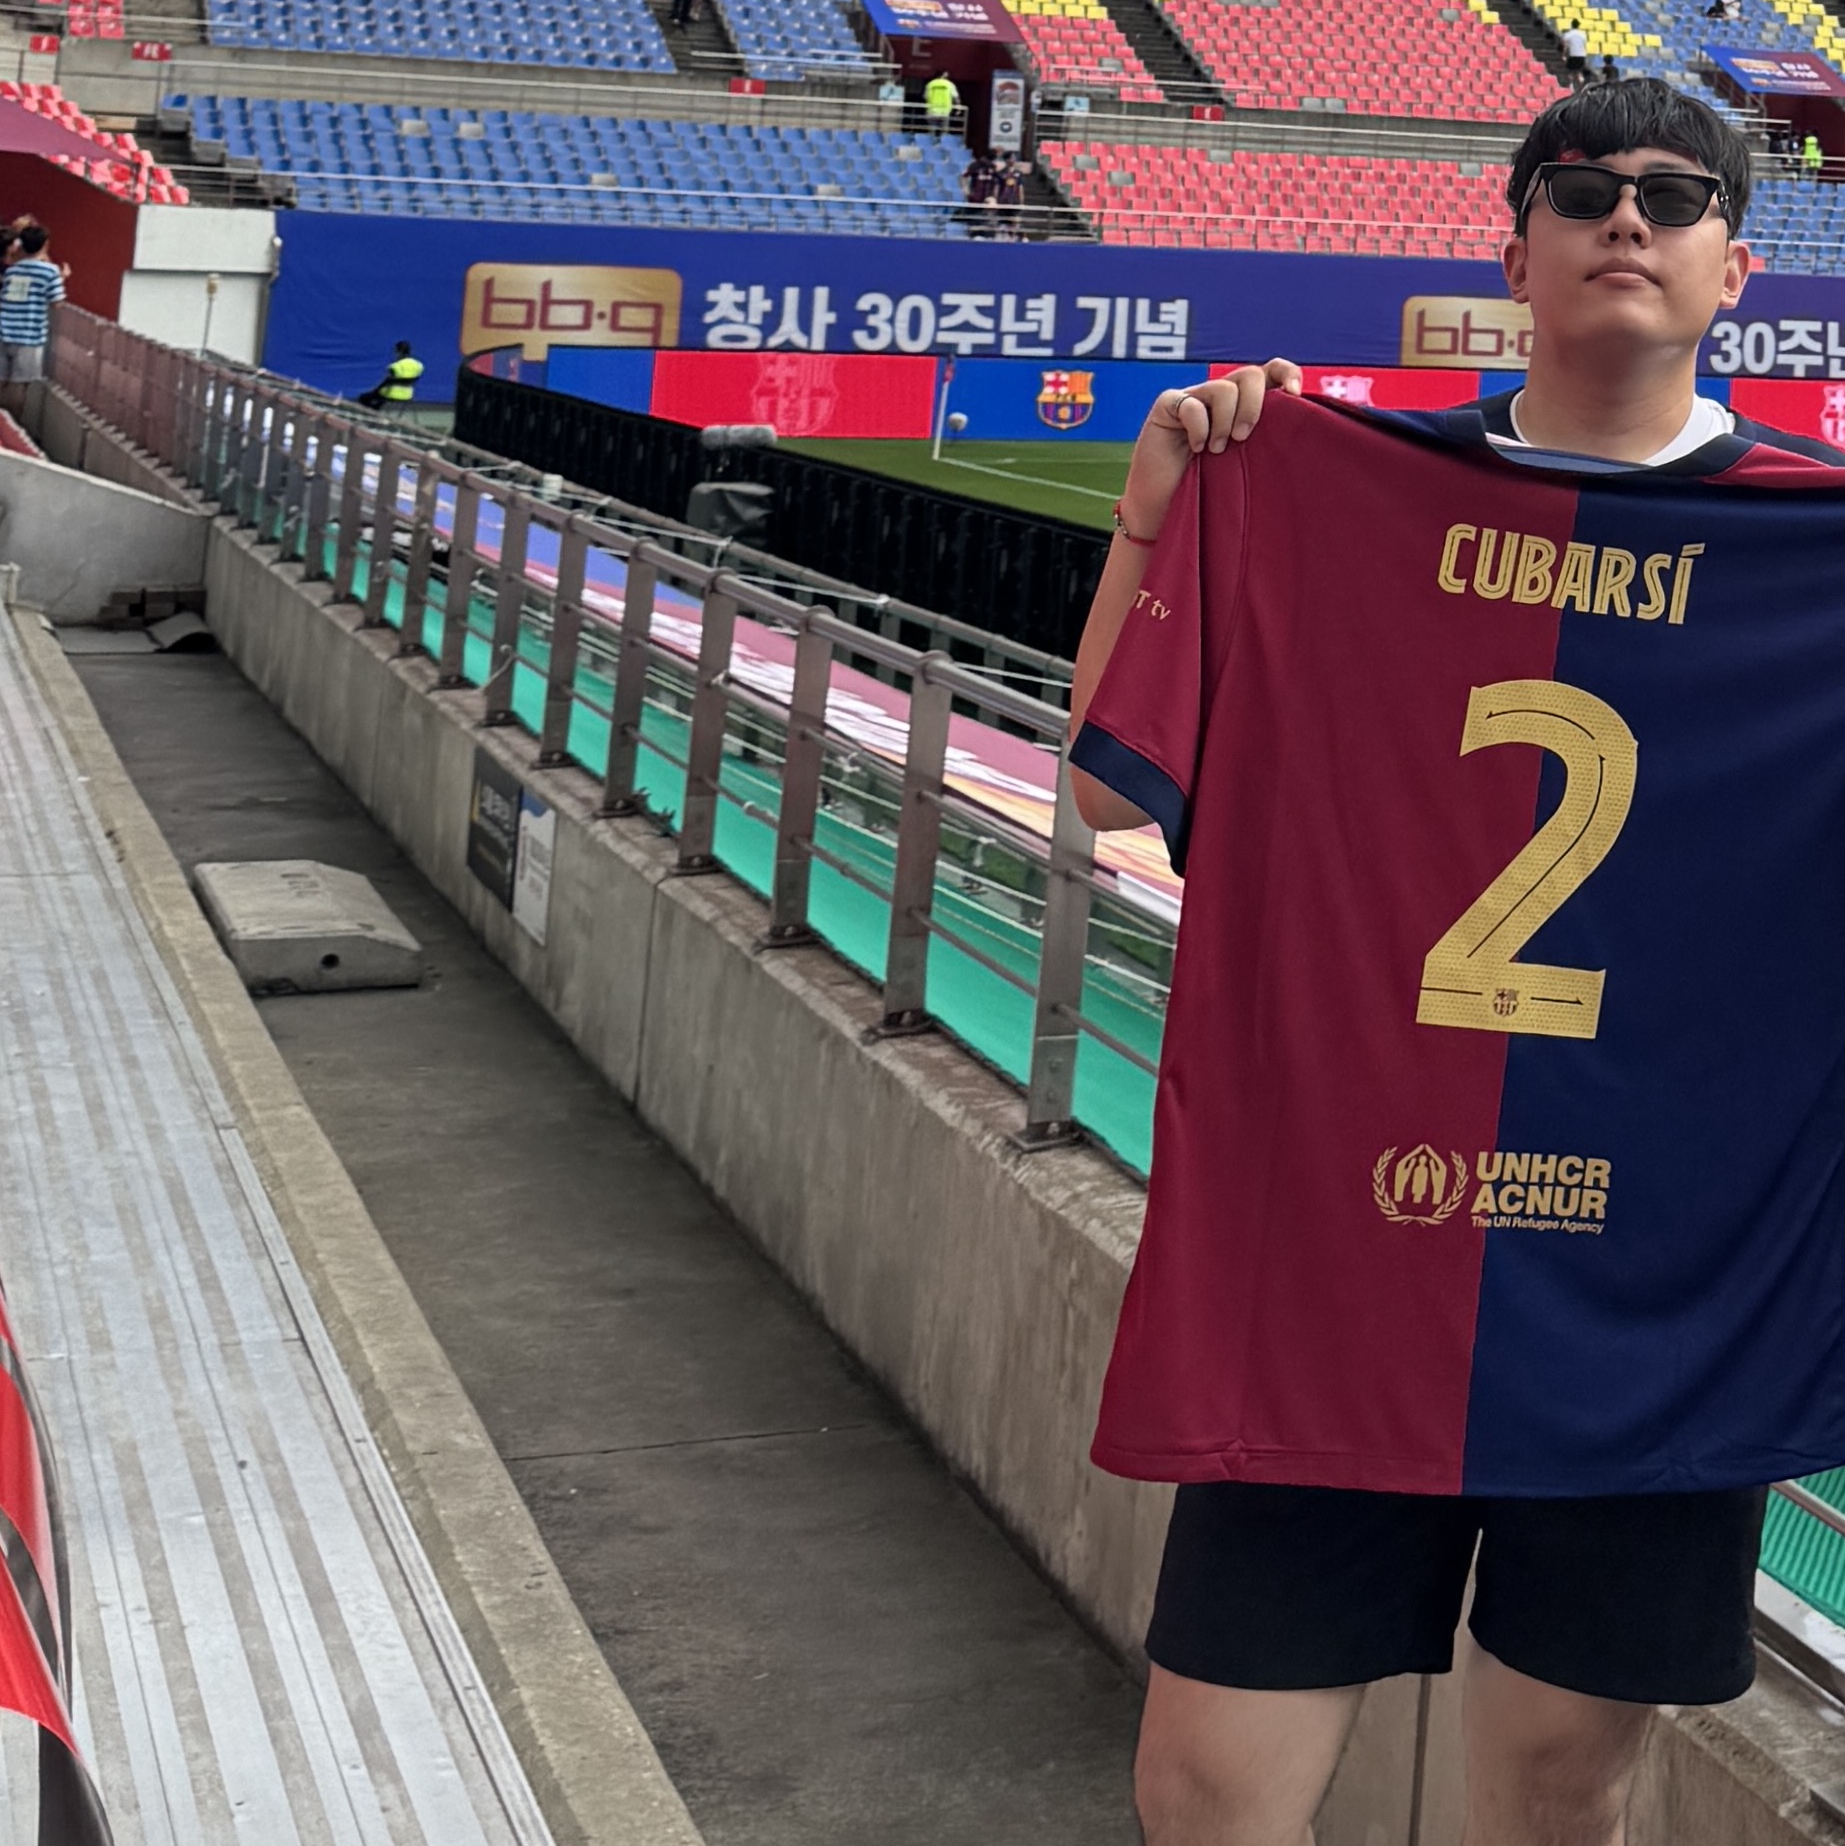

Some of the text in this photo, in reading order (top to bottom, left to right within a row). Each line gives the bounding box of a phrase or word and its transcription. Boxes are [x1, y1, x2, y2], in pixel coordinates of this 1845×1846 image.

[702, 282, 836, 350] 창사
[852, 292, 1056, 356] 30주년
[1073, 296, 1190, 360] 기념
[1437, 523, 1706, 625] CUBARSÍ
[1151, 599, 1172, 621] tv
[1415, 680, 1640, 1039] 2
[1475, 1152, 1612, 1190] UNHCR
[1470, 1184, 1608, 1219] ACNUR
[1471, 1215, 1605, 1235] The UN Refugee Agency
